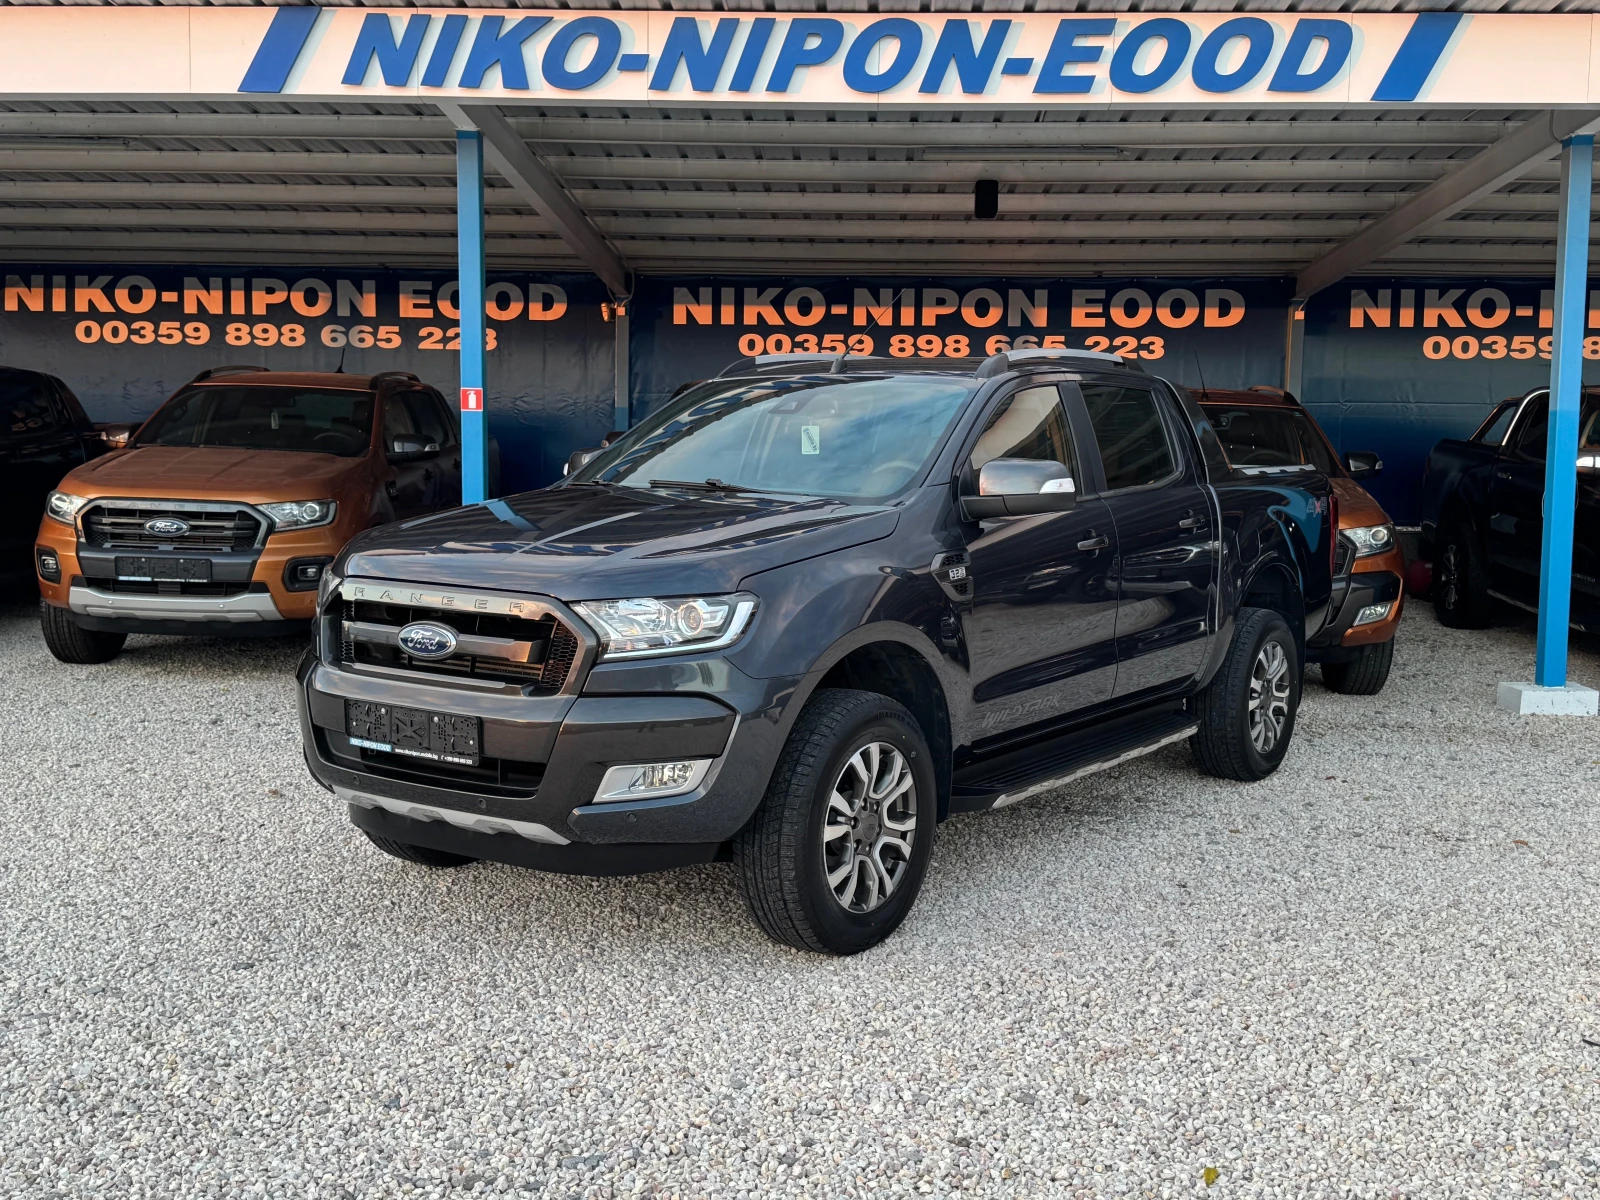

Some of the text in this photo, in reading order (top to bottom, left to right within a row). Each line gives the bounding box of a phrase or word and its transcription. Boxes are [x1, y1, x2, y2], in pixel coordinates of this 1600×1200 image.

[341, 12, 1354, 94] NIKO-NIPON-EOOD
[4, 275, 376, 318] NIKO-NIPON
[673, 286, 1246, 328] NIKO-NIPON EOOD
[75, 320, 210, 344] 00359
[225, 323, 306, 347] 898
[320, 324, 402, 349] 665
[738, 333, 1165, 360] 00359 898 665 223
[154, 521, 177, 532] Ford
[354, 586, 525, 613] RANGER
[407, 629, 440, 650] Ford
